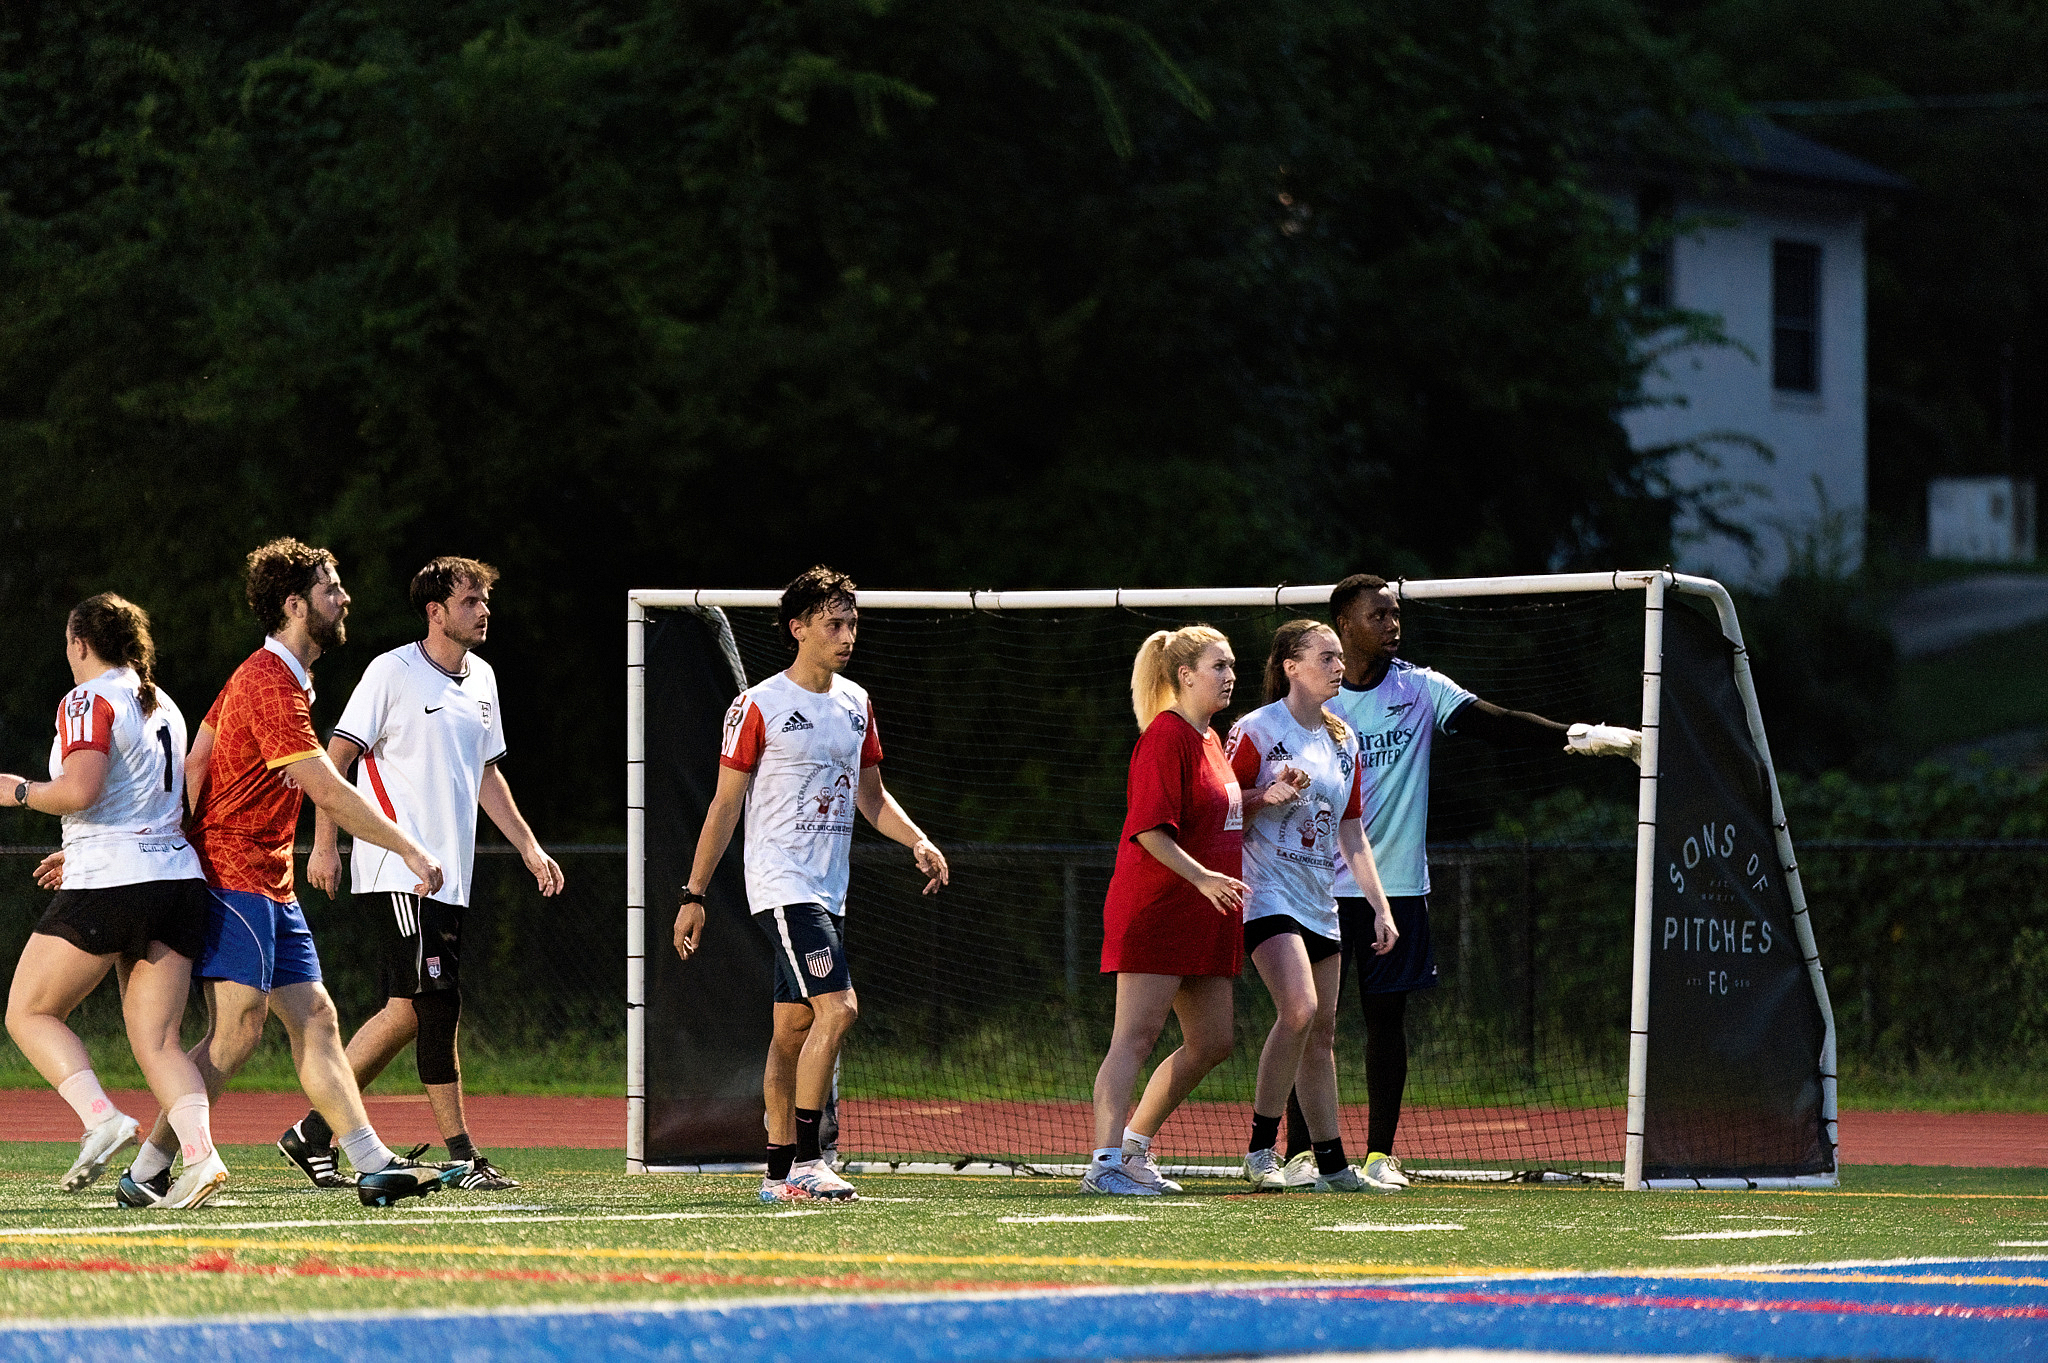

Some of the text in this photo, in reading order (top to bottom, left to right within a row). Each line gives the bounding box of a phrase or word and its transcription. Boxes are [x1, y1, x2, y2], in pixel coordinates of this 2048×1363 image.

[781, 721, 814, 733] adidas
[1358, 728, 1413, 751] irates
[156, 725, 173, 793] 1
[1266, 752, 1293, 762] adidas
[1361, 748, 1402, 768] BETTER
[796, 762, 832, 816] INTERNATIONAL
[1276, 848, 1287, 858] LA
[1669, 821, 1769, 894] SONS OF
[1662, 916, 1773, 954] PITCHES
[1708, 970, 1728, 996] FC
